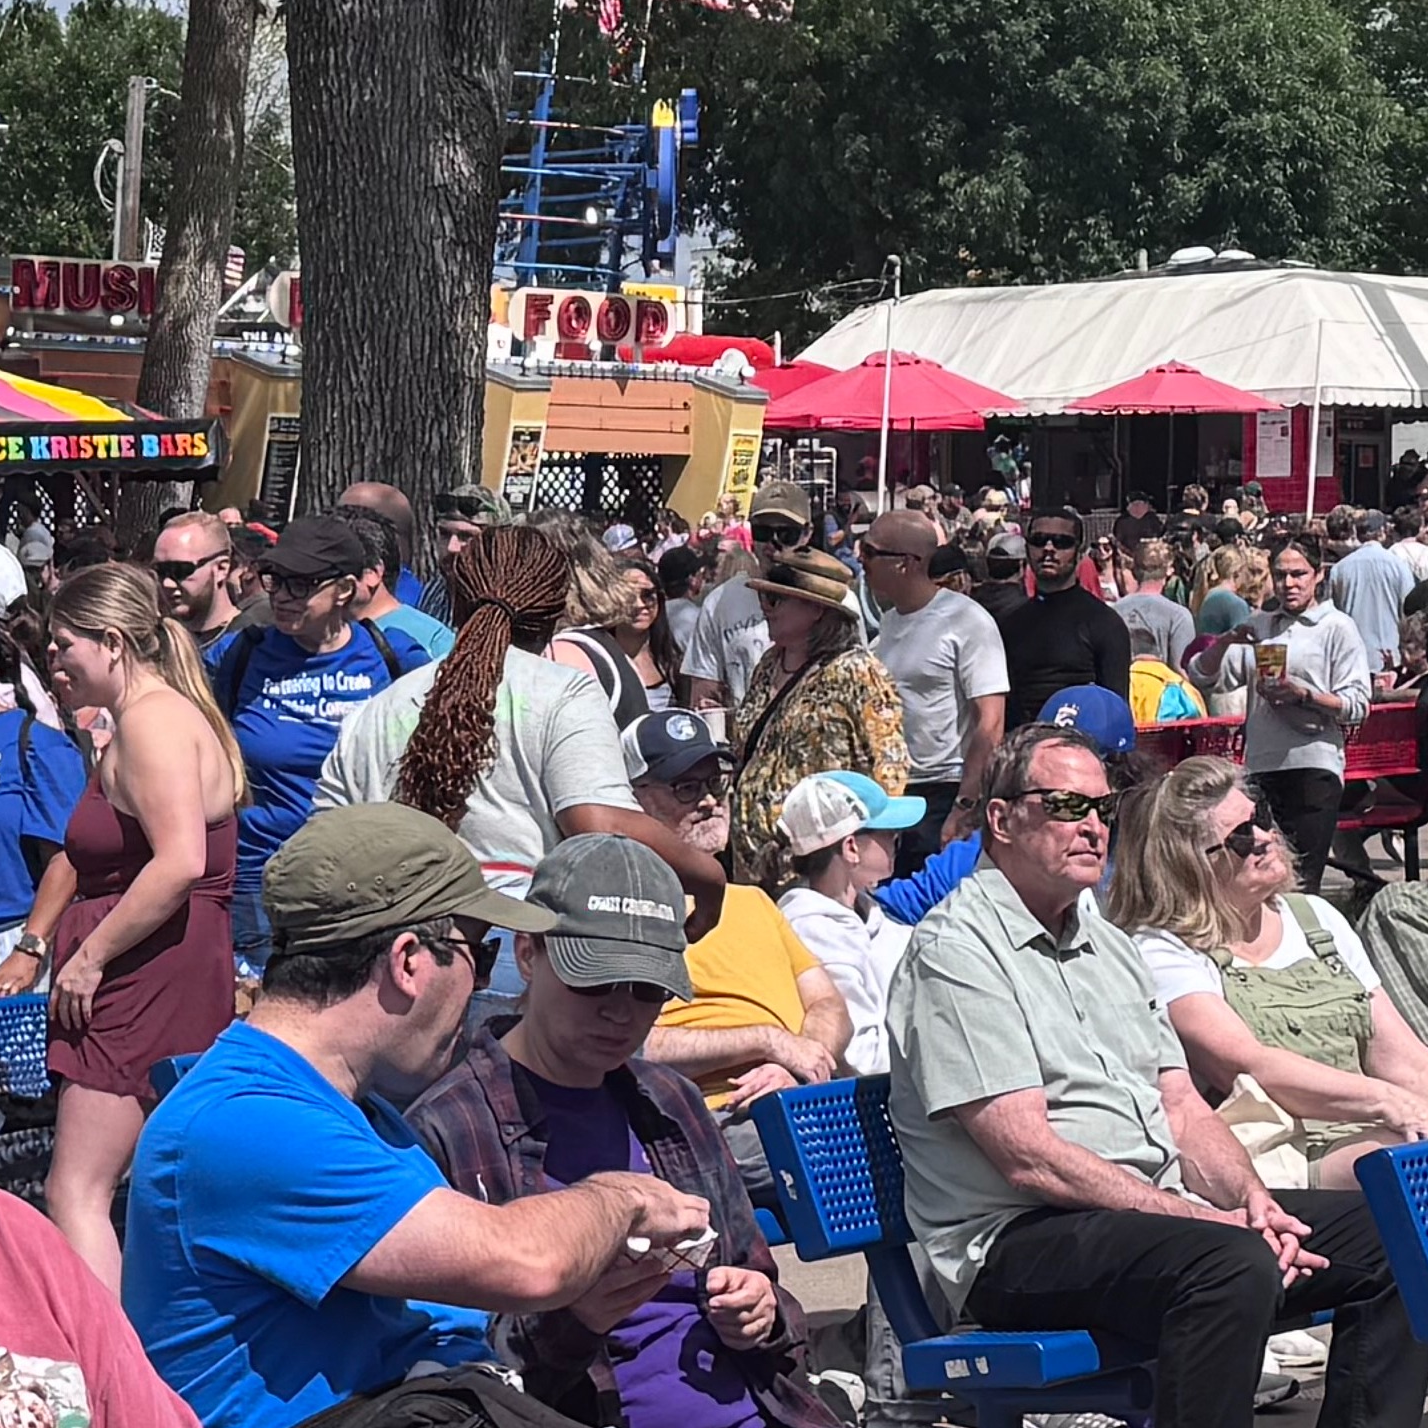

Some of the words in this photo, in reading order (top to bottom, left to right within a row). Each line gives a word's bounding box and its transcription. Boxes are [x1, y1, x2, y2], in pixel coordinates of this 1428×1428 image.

[12, 259, 155, 317] MUSI
[523, 293, 669, 343] FOOD
[29, 434, 136, 460] KRISTIE
[141, 432, 209, 459] BARS
